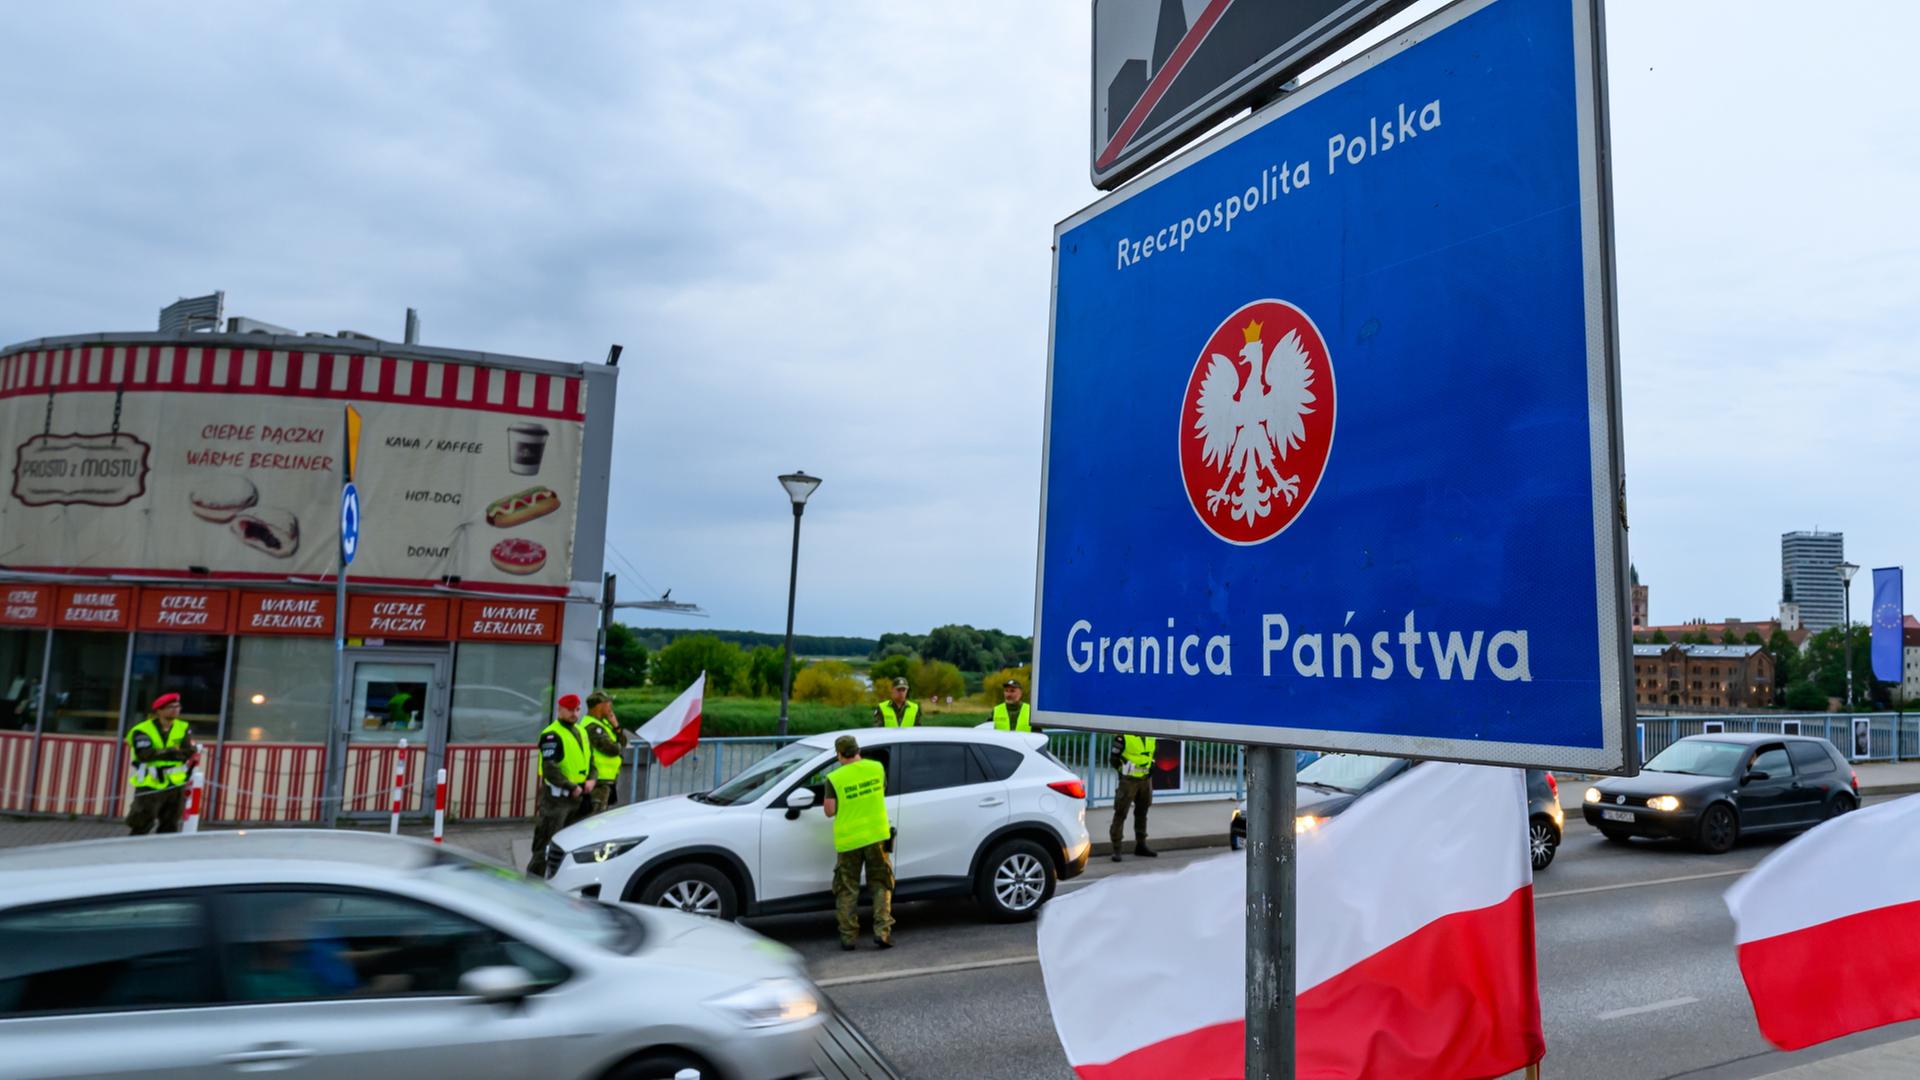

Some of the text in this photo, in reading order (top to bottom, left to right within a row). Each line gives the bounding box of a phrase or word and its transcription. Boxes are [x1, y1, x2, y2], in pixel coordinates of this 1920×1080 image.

[1117, 99, 1442, 270] Rzeczpospolita Polska
[261, 425, 324, 444] PĄCZKI
[385, 436, 421, 449] KAWA
[436, 440, 484, 455] KAFFEE
[22, 459, 67, 478] PROSTO
[80, 458, 138, 478] MOSTU
[249, 452, 333, 472] BERLINER
[407, 545, 450, 558] DONUT
[64, 607, 120, 622] BERLINER
[251, 613, 324, 629] BERLINER
[472, 620, 545, 636] BERLINER
[1066, 610, 1532, 682] Granica Państwa
